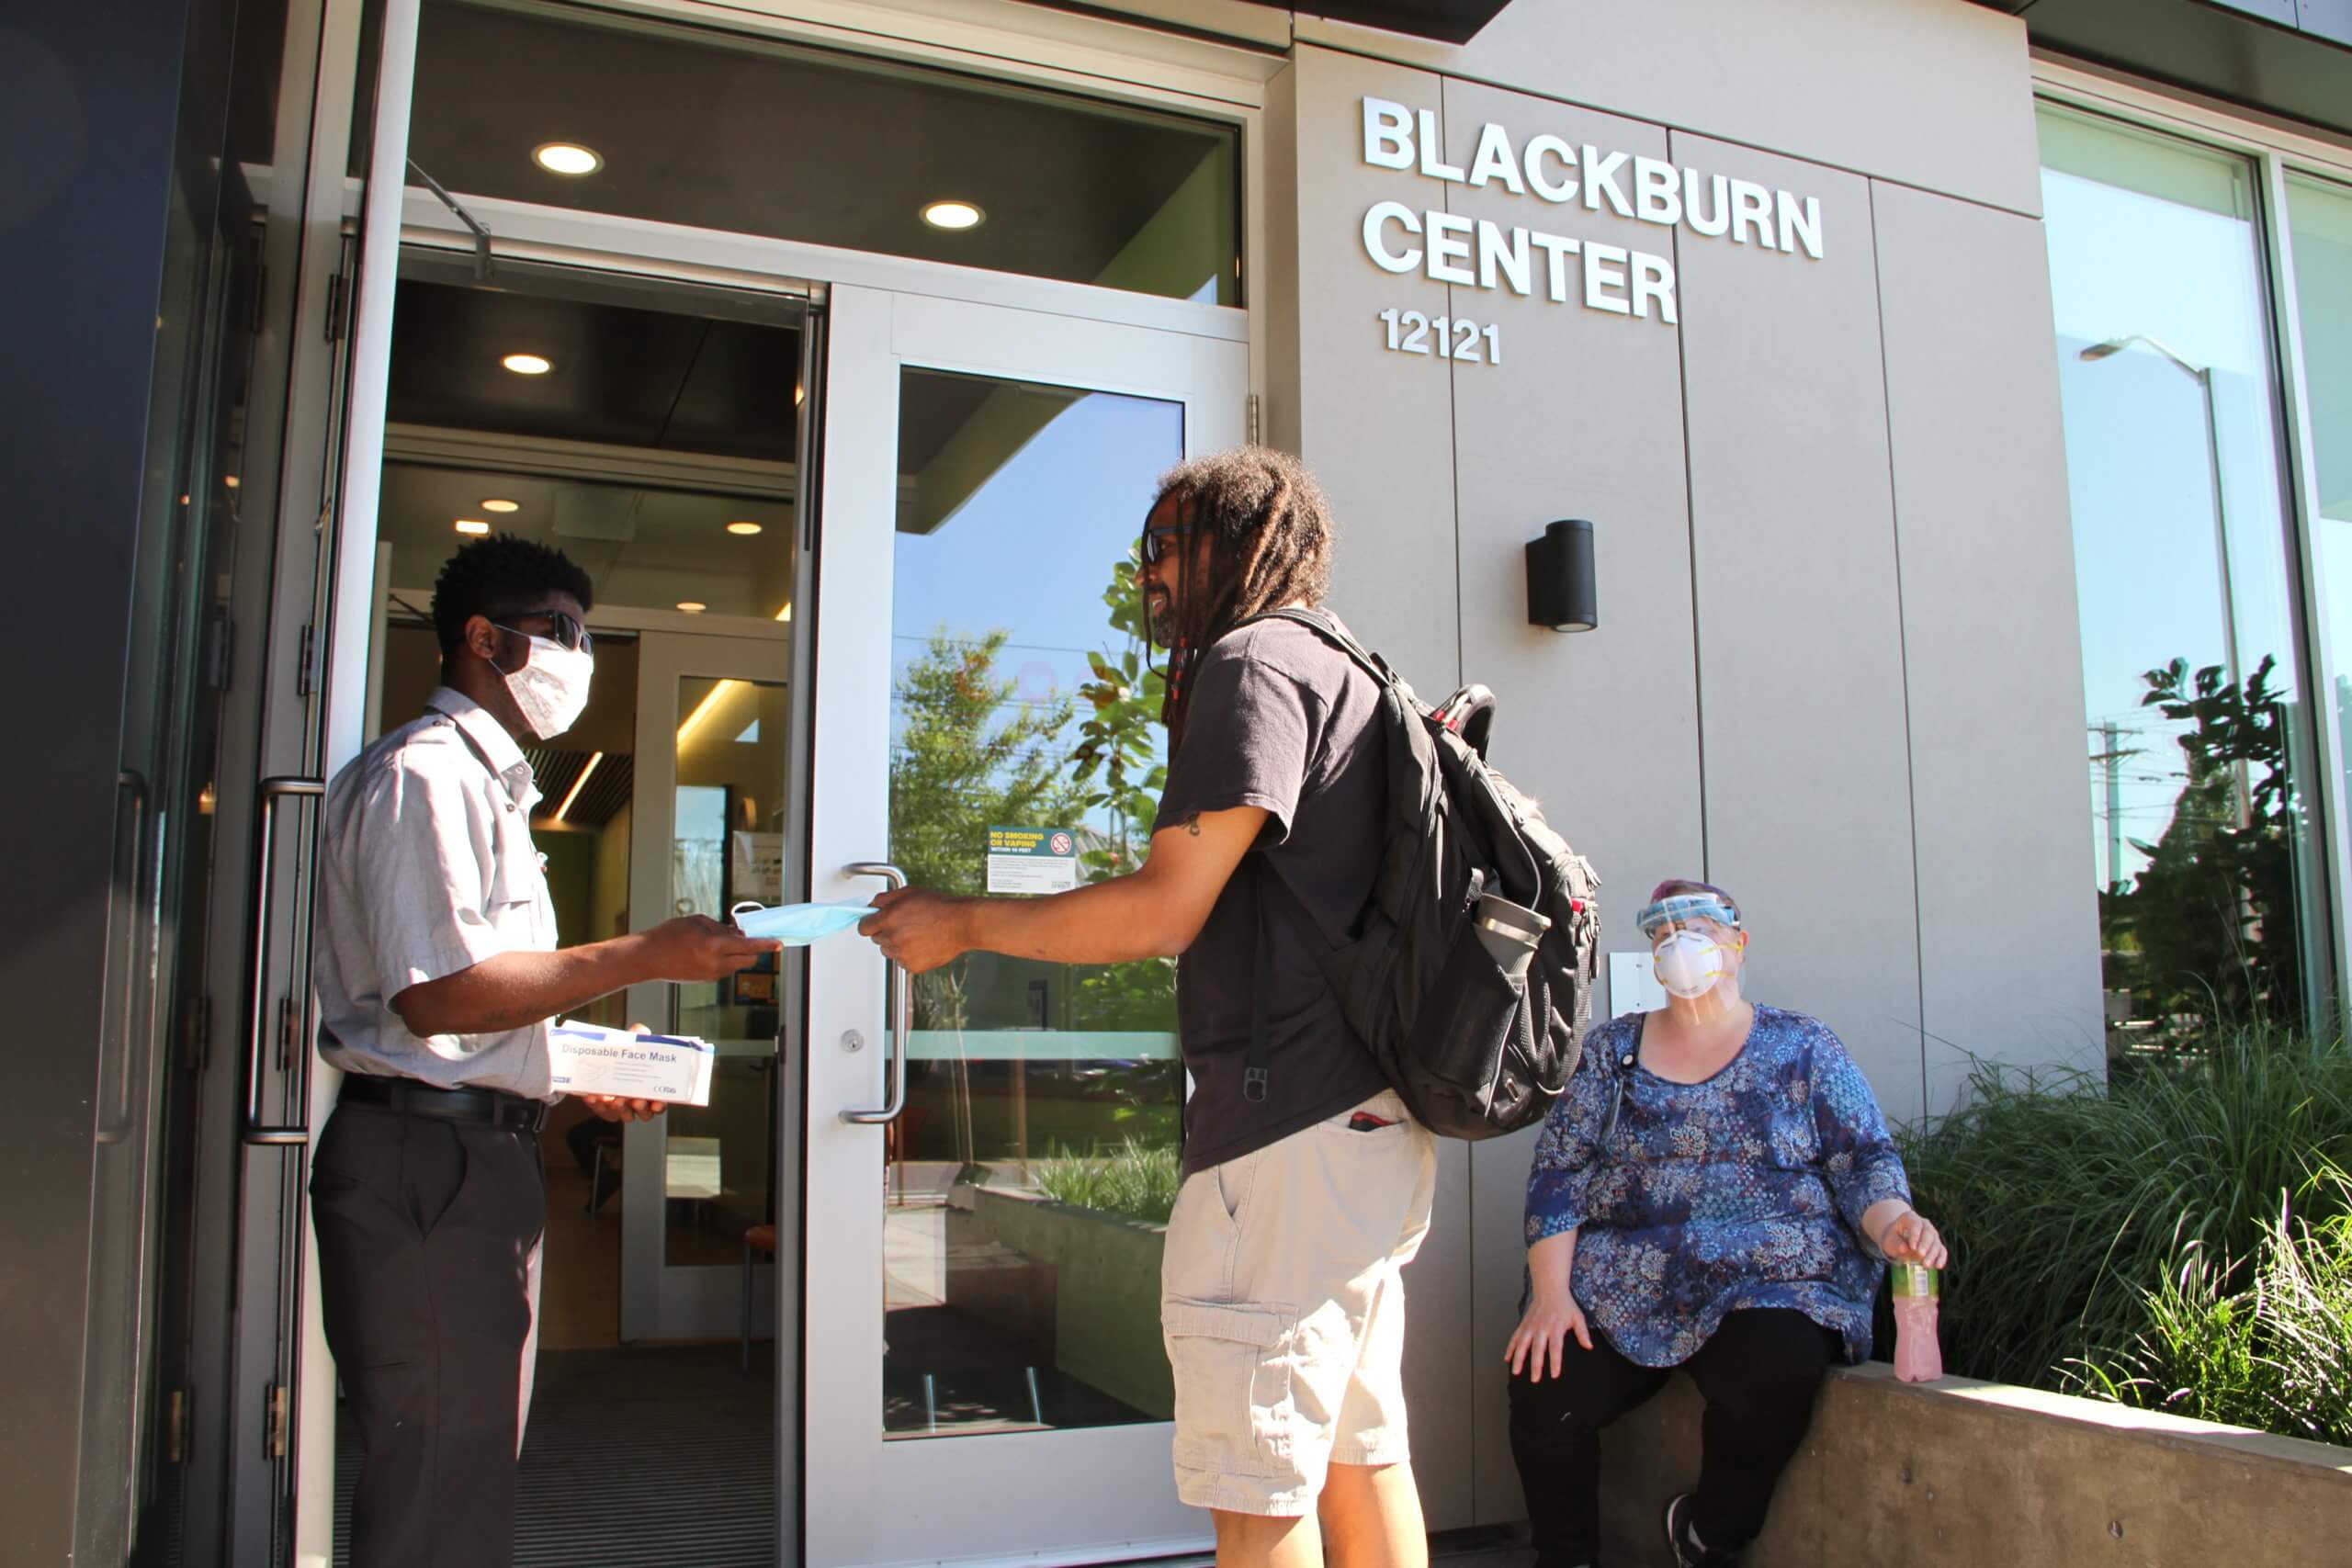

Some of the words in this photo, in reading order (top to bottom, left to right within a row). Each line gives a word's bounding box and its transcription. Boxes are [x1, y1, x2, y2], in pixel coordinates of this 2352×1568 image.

[1362, 96, 1824, 259] BLACKBURN
[1362, 200, 1678, 324] CENTER
[1379, 308, 1500, 364] 12121
[1005, 831, 1044, 840] SMOKING
[561, 1043, 618, 1058] Disposable
[621, 1049, 647, 1061] Face
[649, 1052, 677, 1064] Mask
